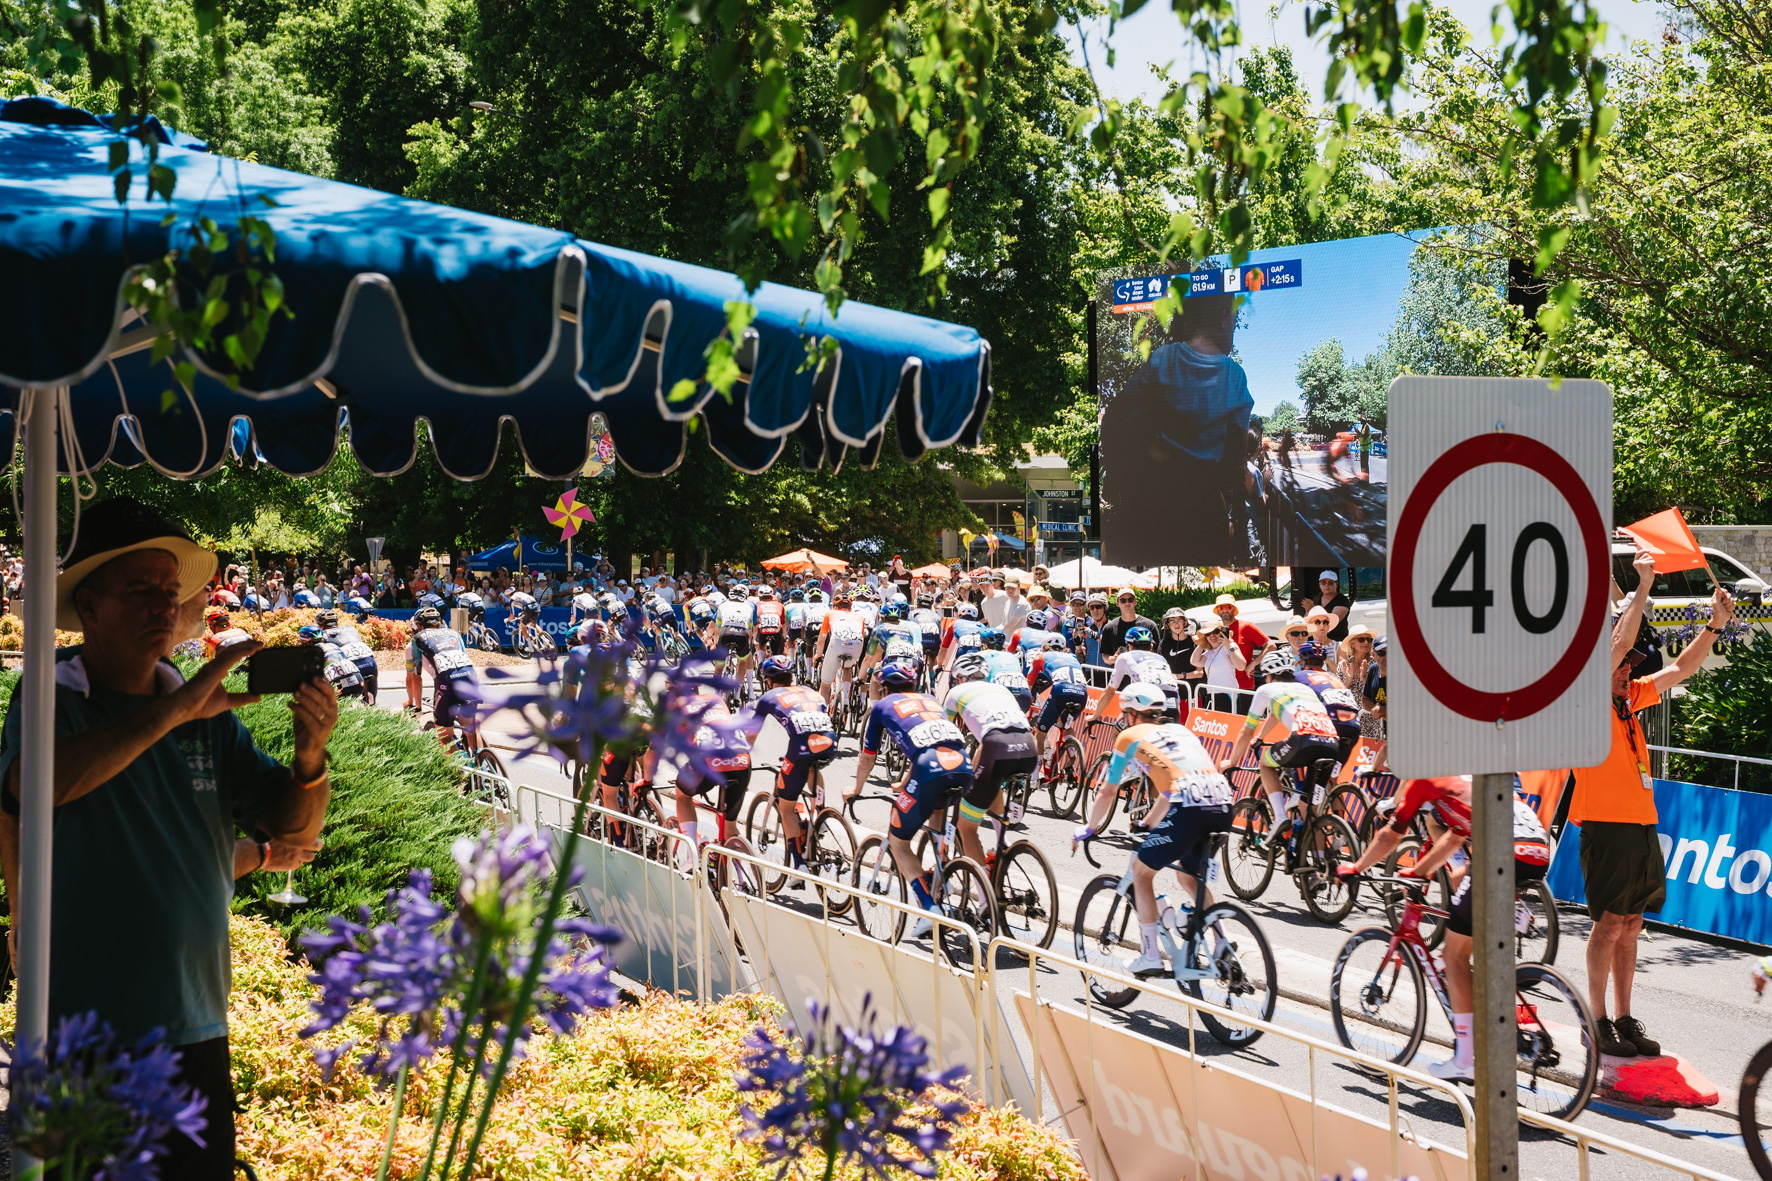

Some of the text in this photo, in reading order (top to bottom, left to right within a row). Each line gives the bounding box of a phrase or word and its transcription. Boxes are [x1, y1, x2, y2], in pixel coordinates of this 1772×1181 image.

[1229, 275, 1236, 285] P
[1042, 490, 1069, 498] JOHNSTON
[1042, 523, 1077, 531] MEDICAL CLINIC
[1432, 521, 1569, 635] 40
[505, 619, 568, 635] Stos
[1192, 716, 1229, 737] Santos
[1139, 748, 1171, 770] SCOTT
